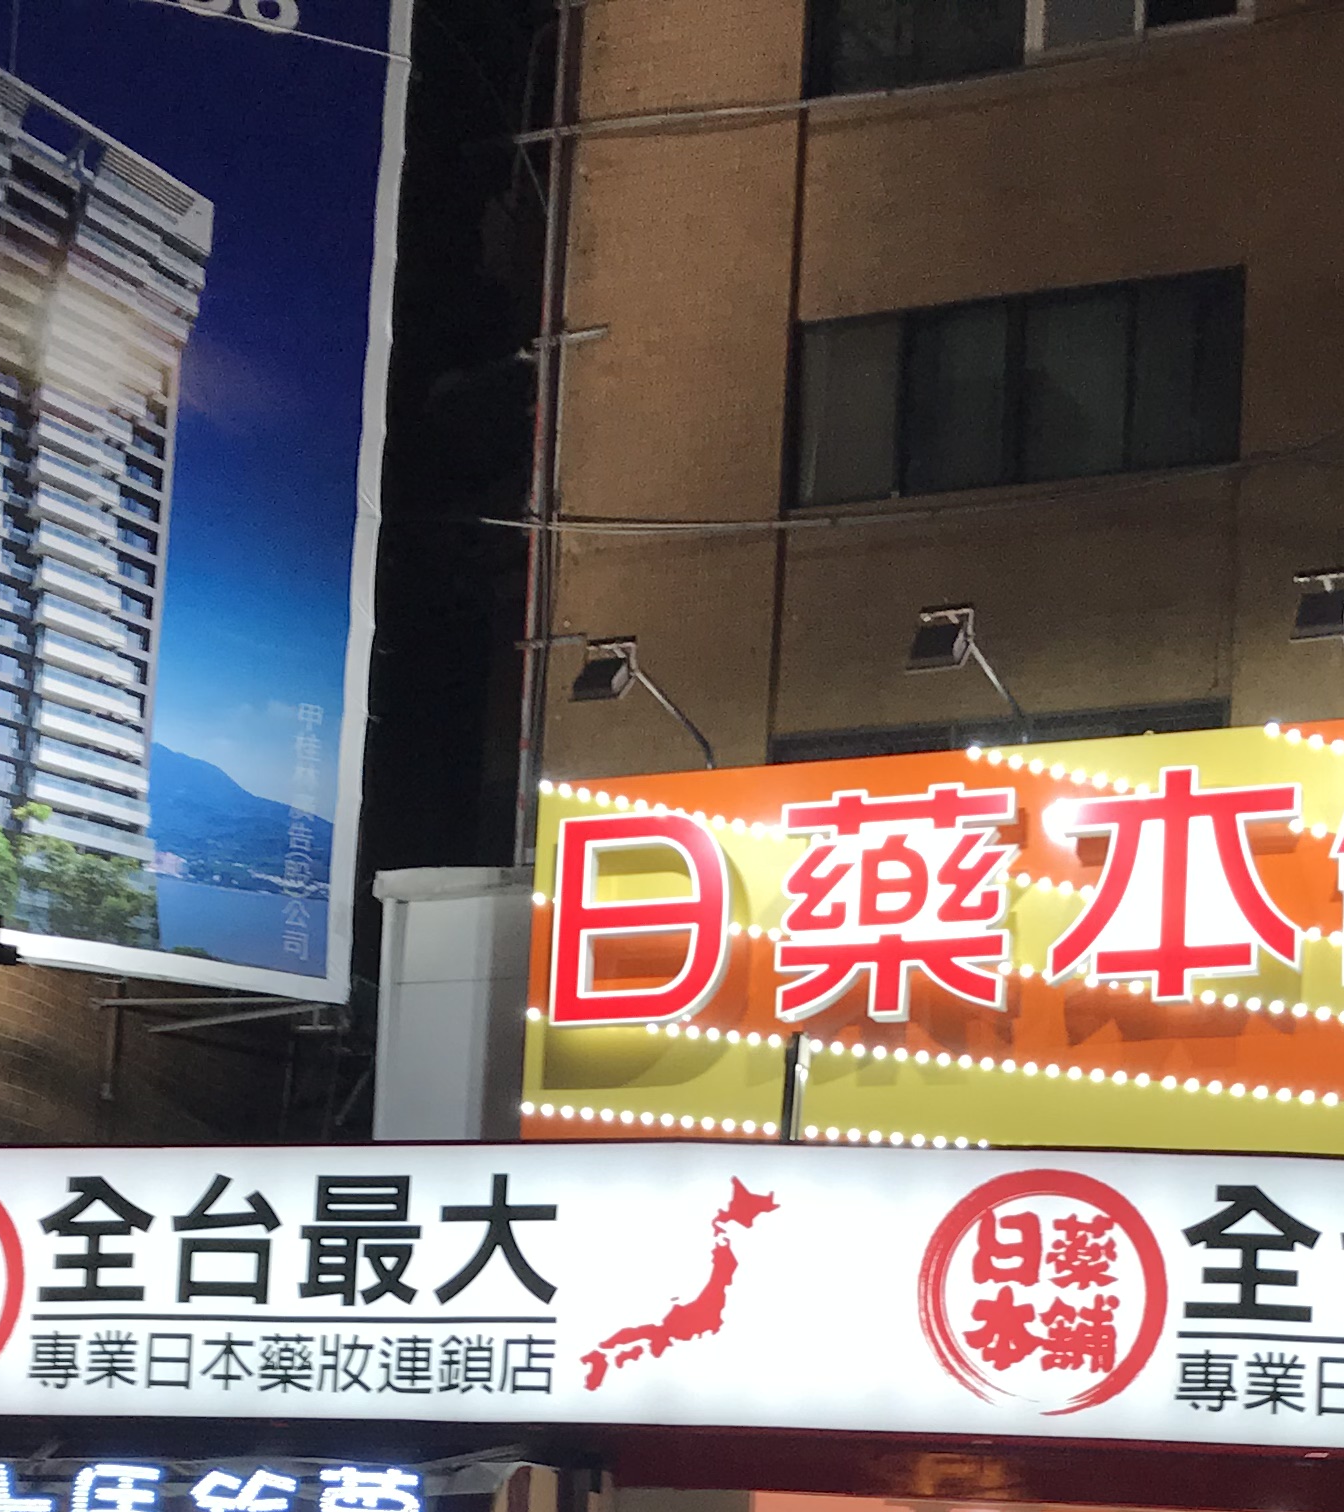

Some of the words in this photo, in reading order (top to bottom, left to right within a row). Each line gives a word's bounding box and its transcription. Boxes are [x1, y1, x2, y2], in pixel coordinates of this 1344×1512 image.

[37, 1172, 560, 1307] 全台最大
[27, 1330, 557, 1397] 專業日本藥妝連鎖店
